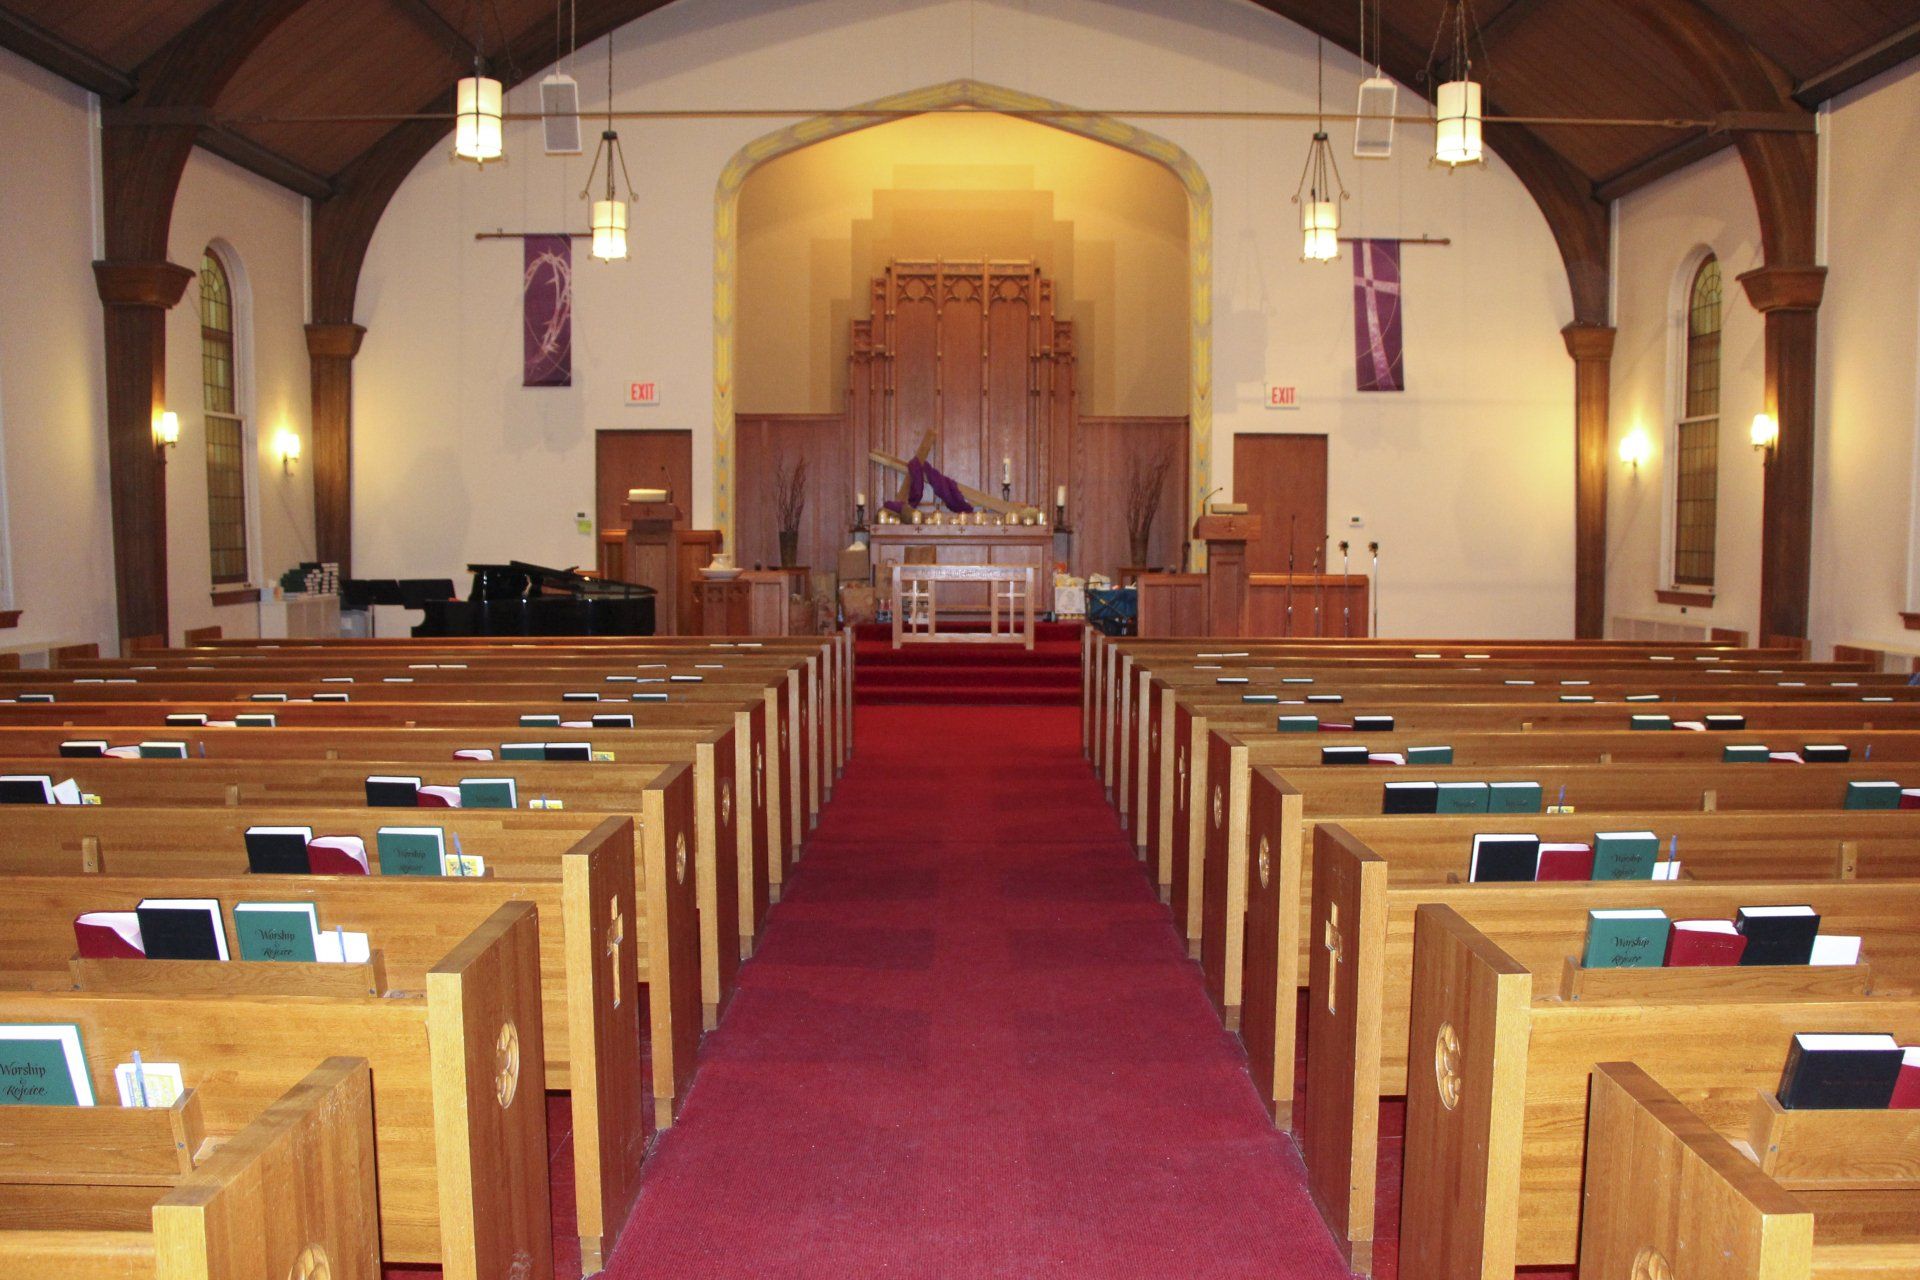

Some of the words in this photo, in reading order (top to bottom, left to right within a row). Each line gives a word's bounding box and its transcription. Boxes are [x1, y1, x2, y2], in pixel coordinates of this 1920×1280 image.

[631, 383, 656, 401] EXIT
[1271, 387, 1296, 404] EXIT
[256, 928, 296, 942] Worship
[1613, 936, 1651, 948] Worship
[0, 1061, 46, 1078] Worship
